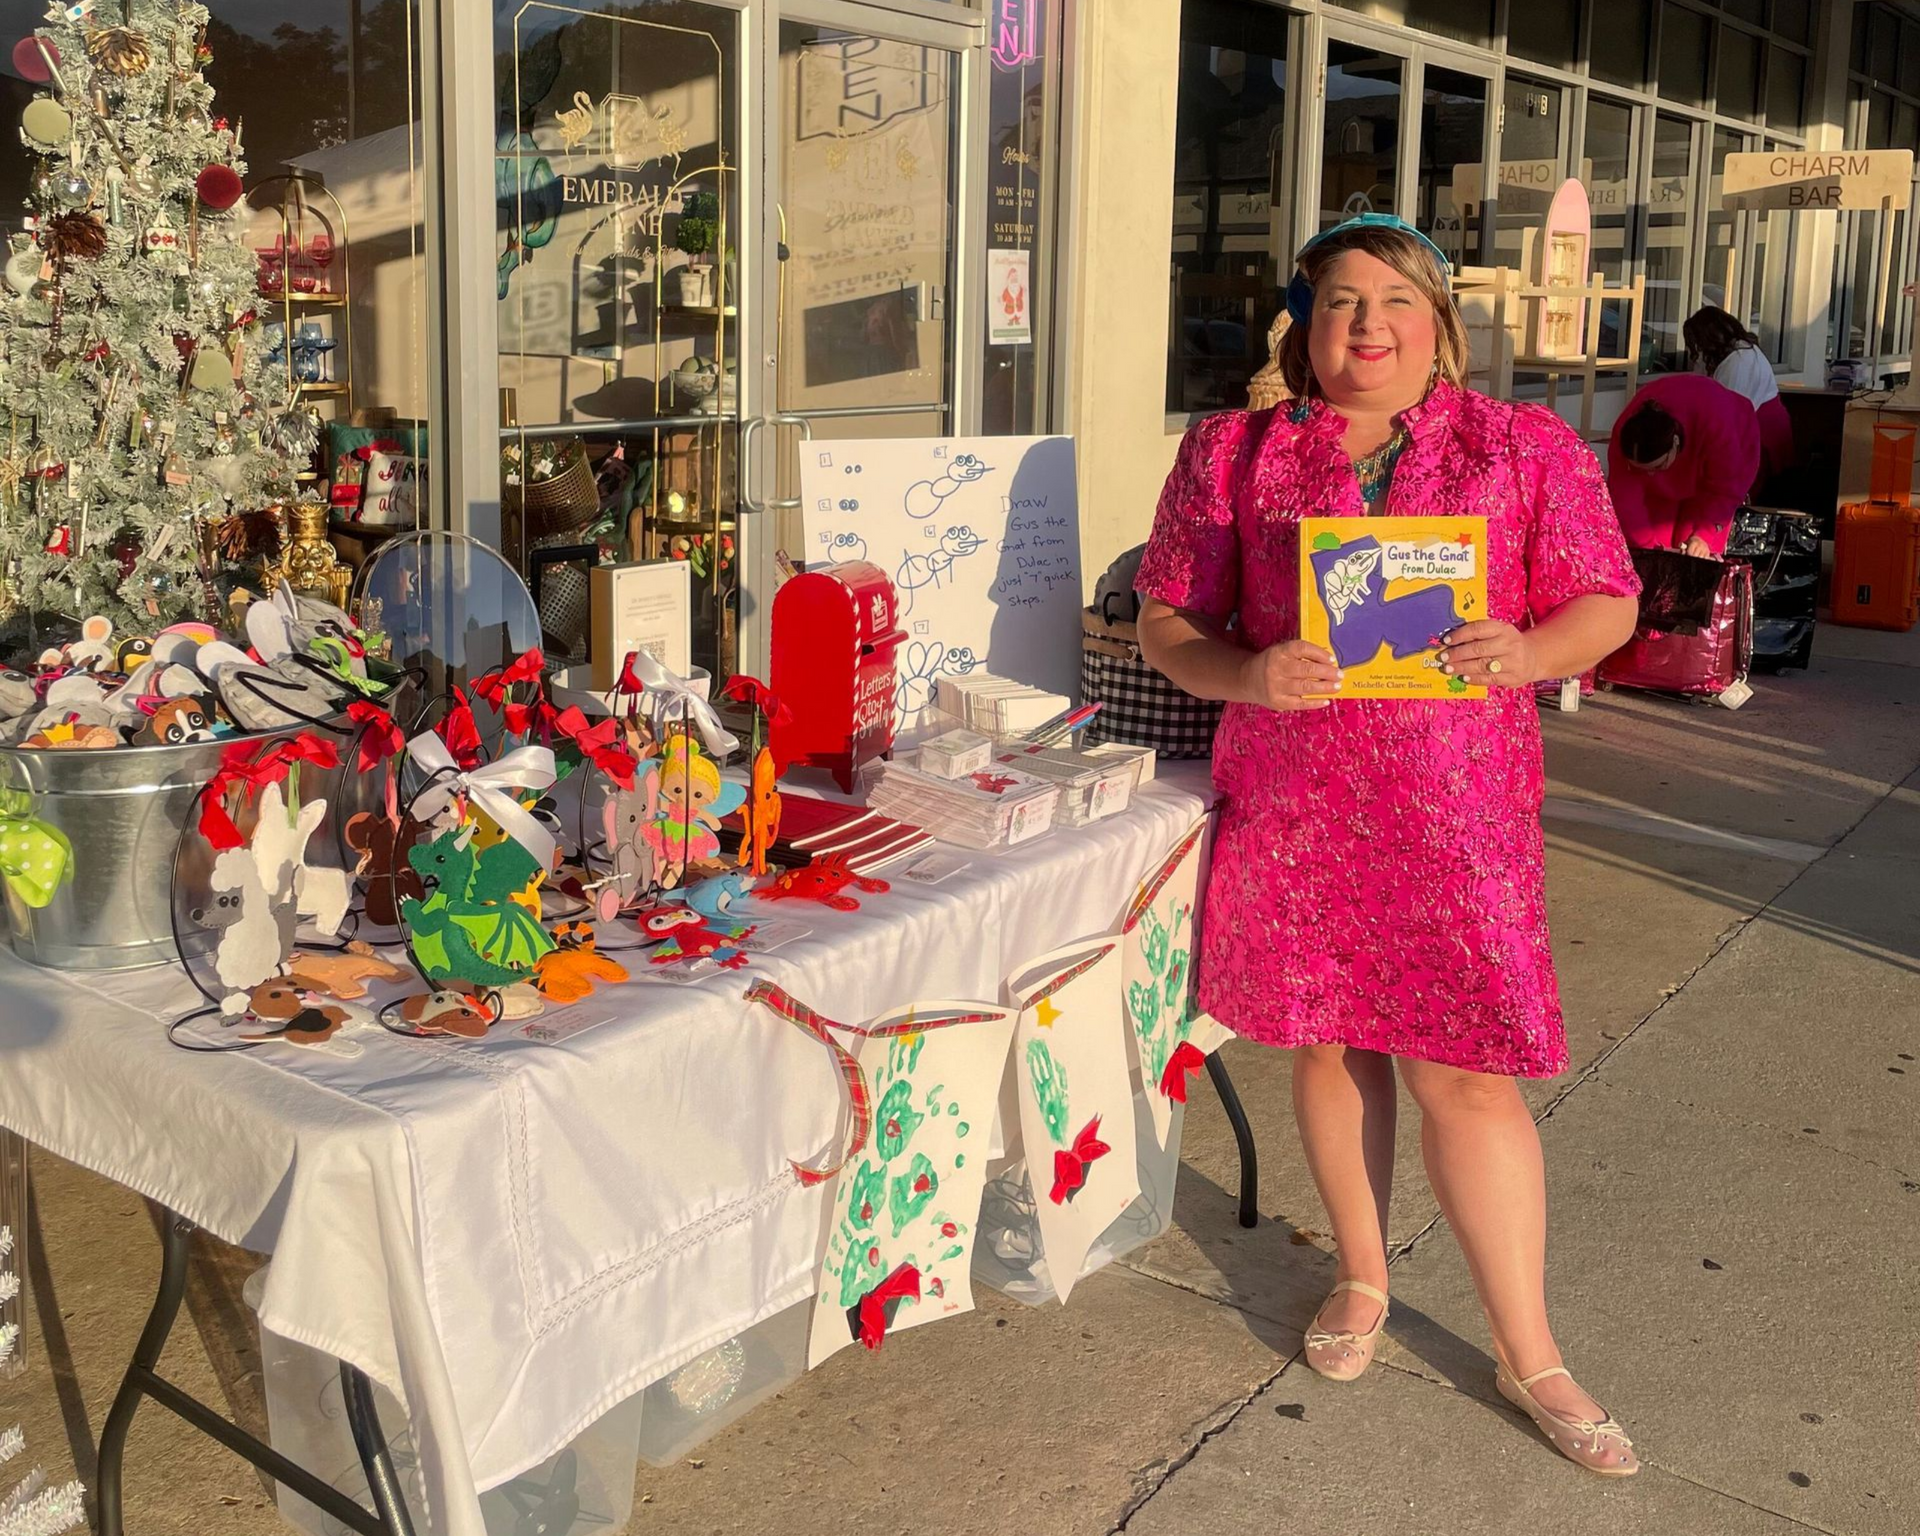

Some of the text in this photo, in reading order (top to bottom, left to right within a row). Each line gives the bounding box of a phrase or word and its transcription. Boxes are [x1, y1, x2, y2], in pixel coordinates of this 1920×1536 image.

[1002, 146, 1030, 166] Hours
[1770, 155, 1870, 177] CHARM
[562, 176, 683, 208] EMERALD
[995, 186, 1035, 199] MON FRI
[1788, 186, 1844, 206] BAR
[994, 222, 1035, 234] SATURDAY
[1000, 495, 1048, 513] Draw
[1010, 516, 1069, 531] Gus the
[996, 535, 1065, 553] Gnat from
[1016, 555, 1069, 568] Dulac in
[1388, 545, 1470, 562] Gus the Gnat
[1401, 562, 1456, 574] from Dulac
[997, 573, 1022, 593] just
[860, 671, 891, 700] Letters
[1352, 681, 1433, 689] Michelle Clare Benoit
[867, 699, 877, 712] to
[858, 695, 889, 739] Santa
